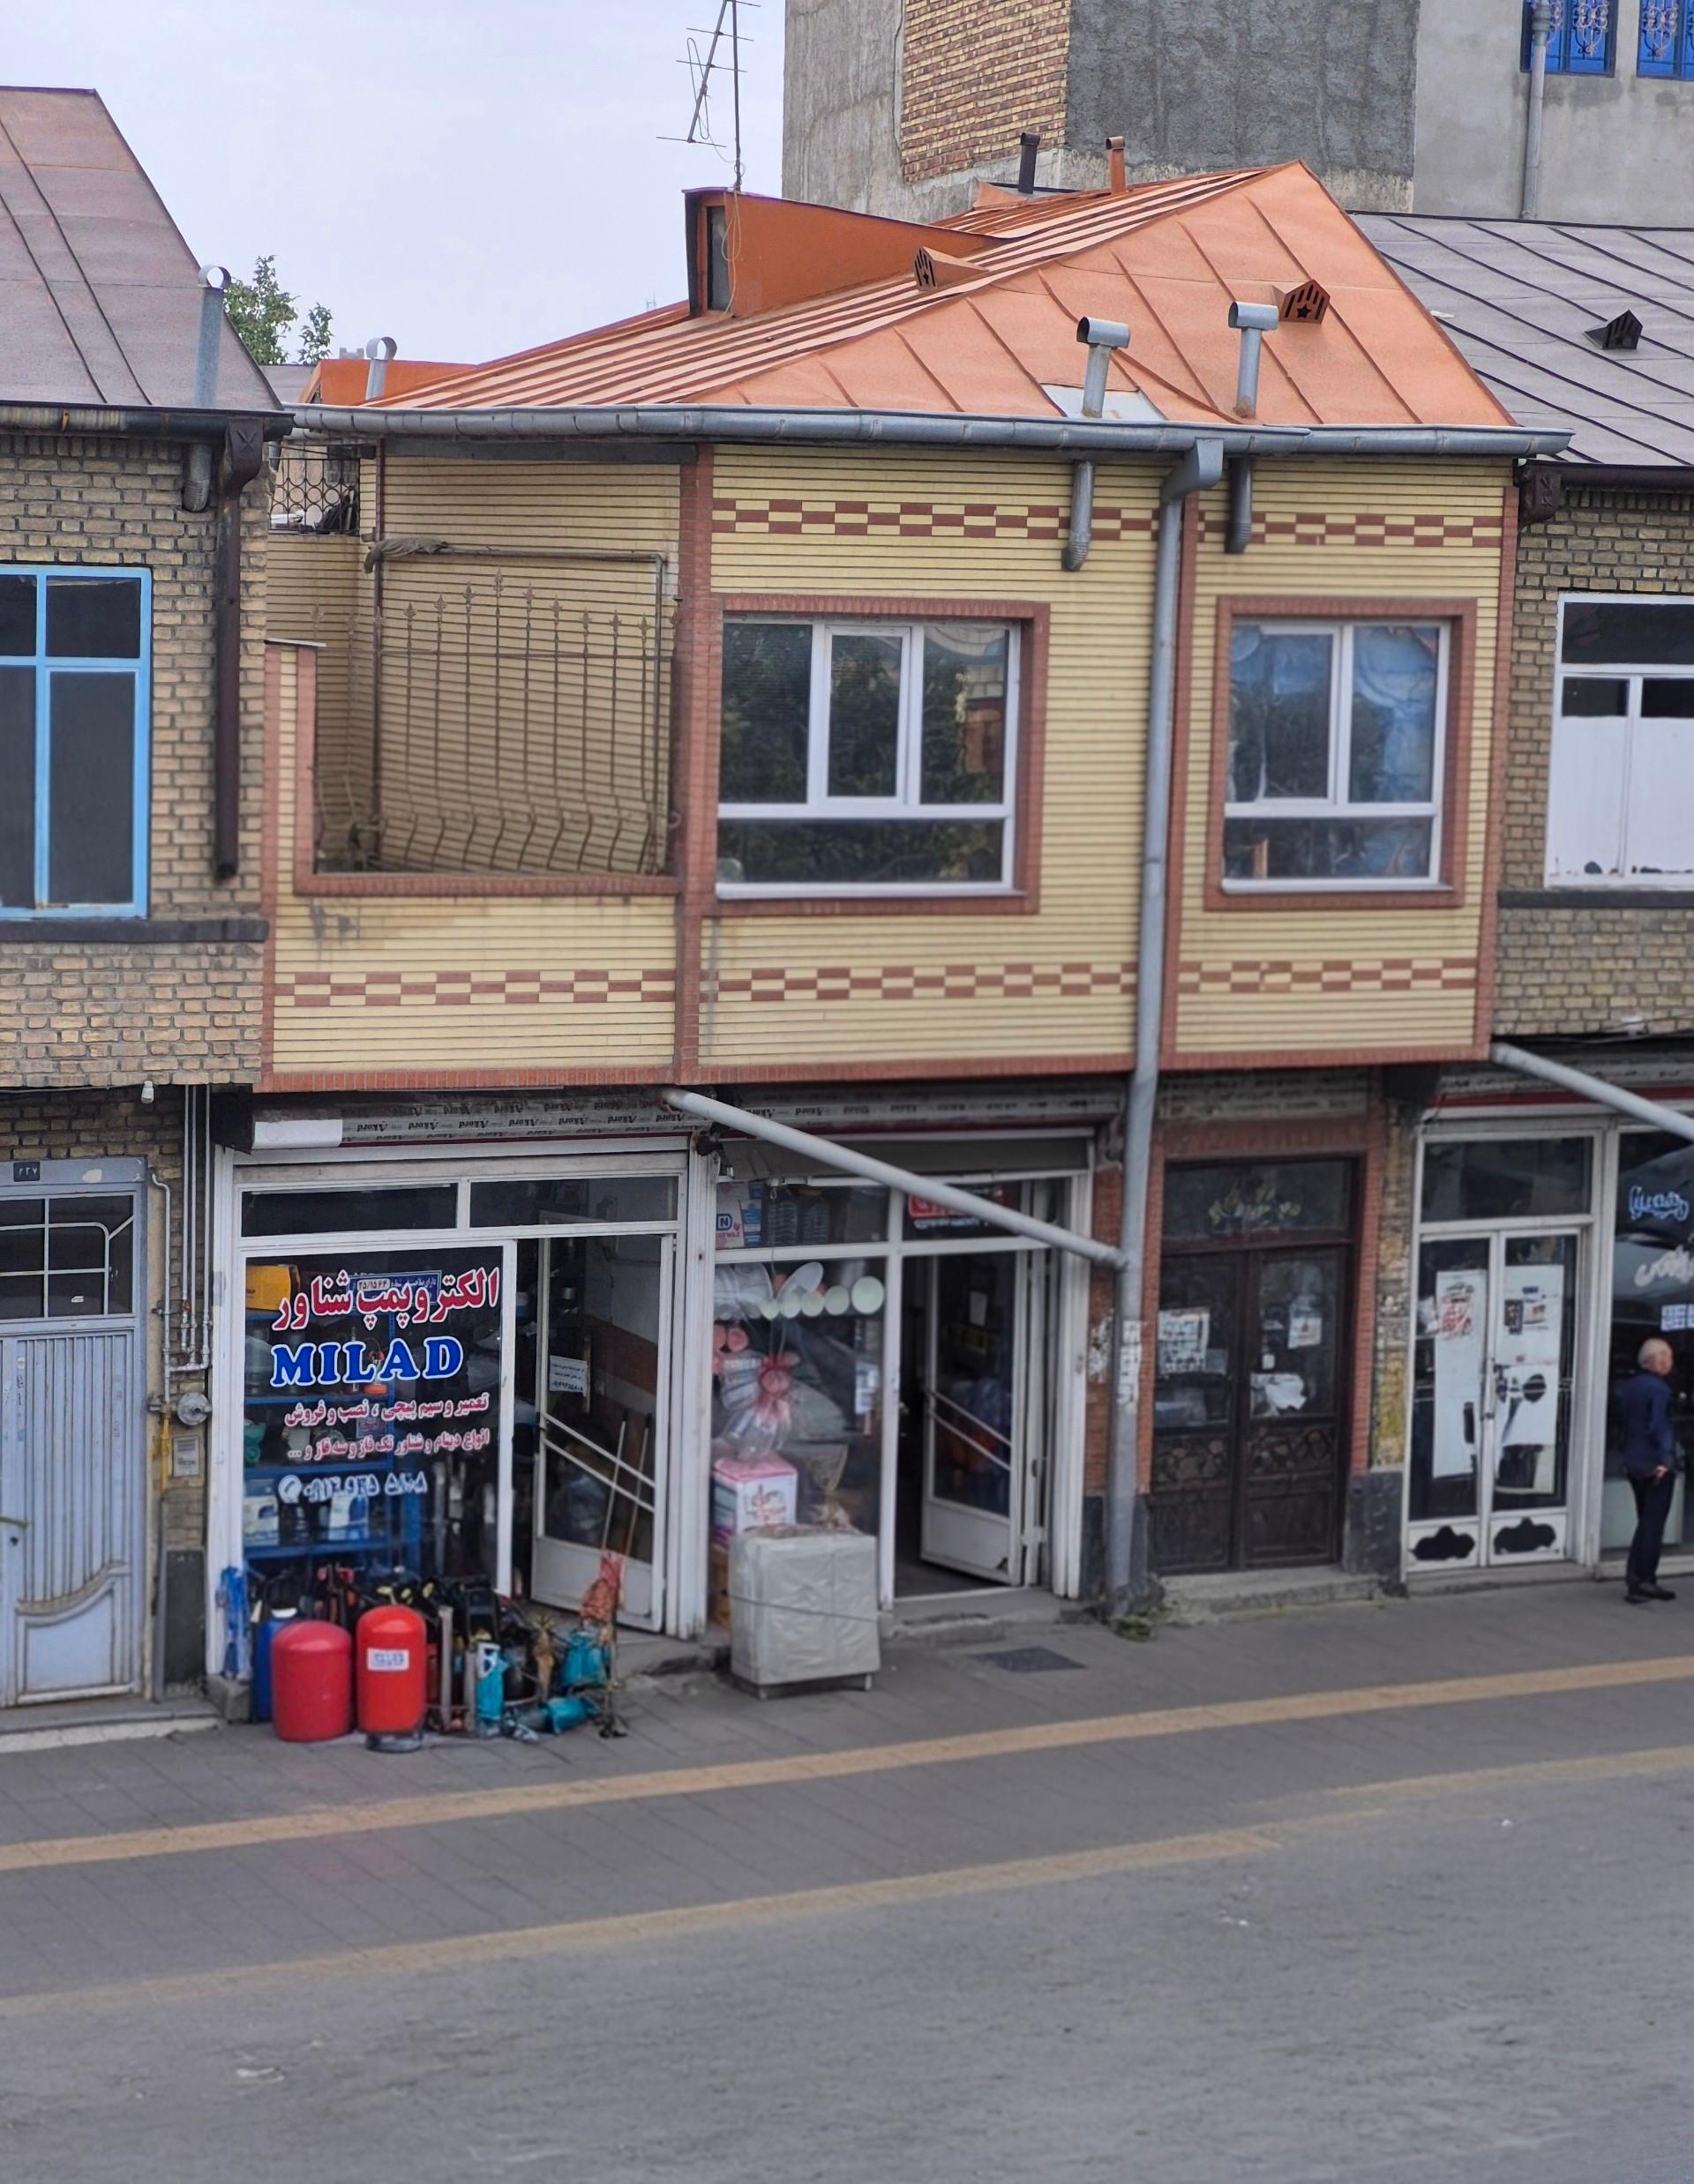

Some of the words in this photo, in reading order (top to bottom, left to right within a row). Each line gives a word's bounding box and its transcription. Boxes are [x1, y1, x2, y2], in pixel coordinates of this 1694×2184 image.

[356, 1120, 388, 1133] Akord
[408, 1118, 439, 1131] Akord
[459, 1118, 490, 1129] Akord
[508, 1116, 539, 1127] Akord
[558, 1114, 588, 1126] Akord
[607, 1112, 638, 1124] Akord
[656, 1112, 685, 1123] Akord
[272, 1269, 353, 1330] شناور
[356, 1267, 500, 1330] الکتروپمپ
[270, 1335, 464, 1387] MILAD
[284, 1399, 326, 1426] فروش
[338, 1398, 370, 1424] نصب
[381, 1400, 416, 1421] پیچی
[418, 1400, 444, 1419] سیم
[443, 1400, 453, 1417] و
[454, 1392, 490, 1417] تعمیر
[326, 1408, 336, 1425] و
[313, 1438, 332, 1461] فاز
[331, 1441, 348, 1454] سه
[357, 1434, 375, 1459] فاز
[375, 1434, 394, 1452] تک
[394, 1432, 424, 1455] شناور
[424, 1439, 433, 1454] و
[434, 1431, 461, 1453] دینام
[461, 1428, 491, 1451] انواع
[304, 1445, 312, 1461] و
[348, 1443, 356, 1459] و
